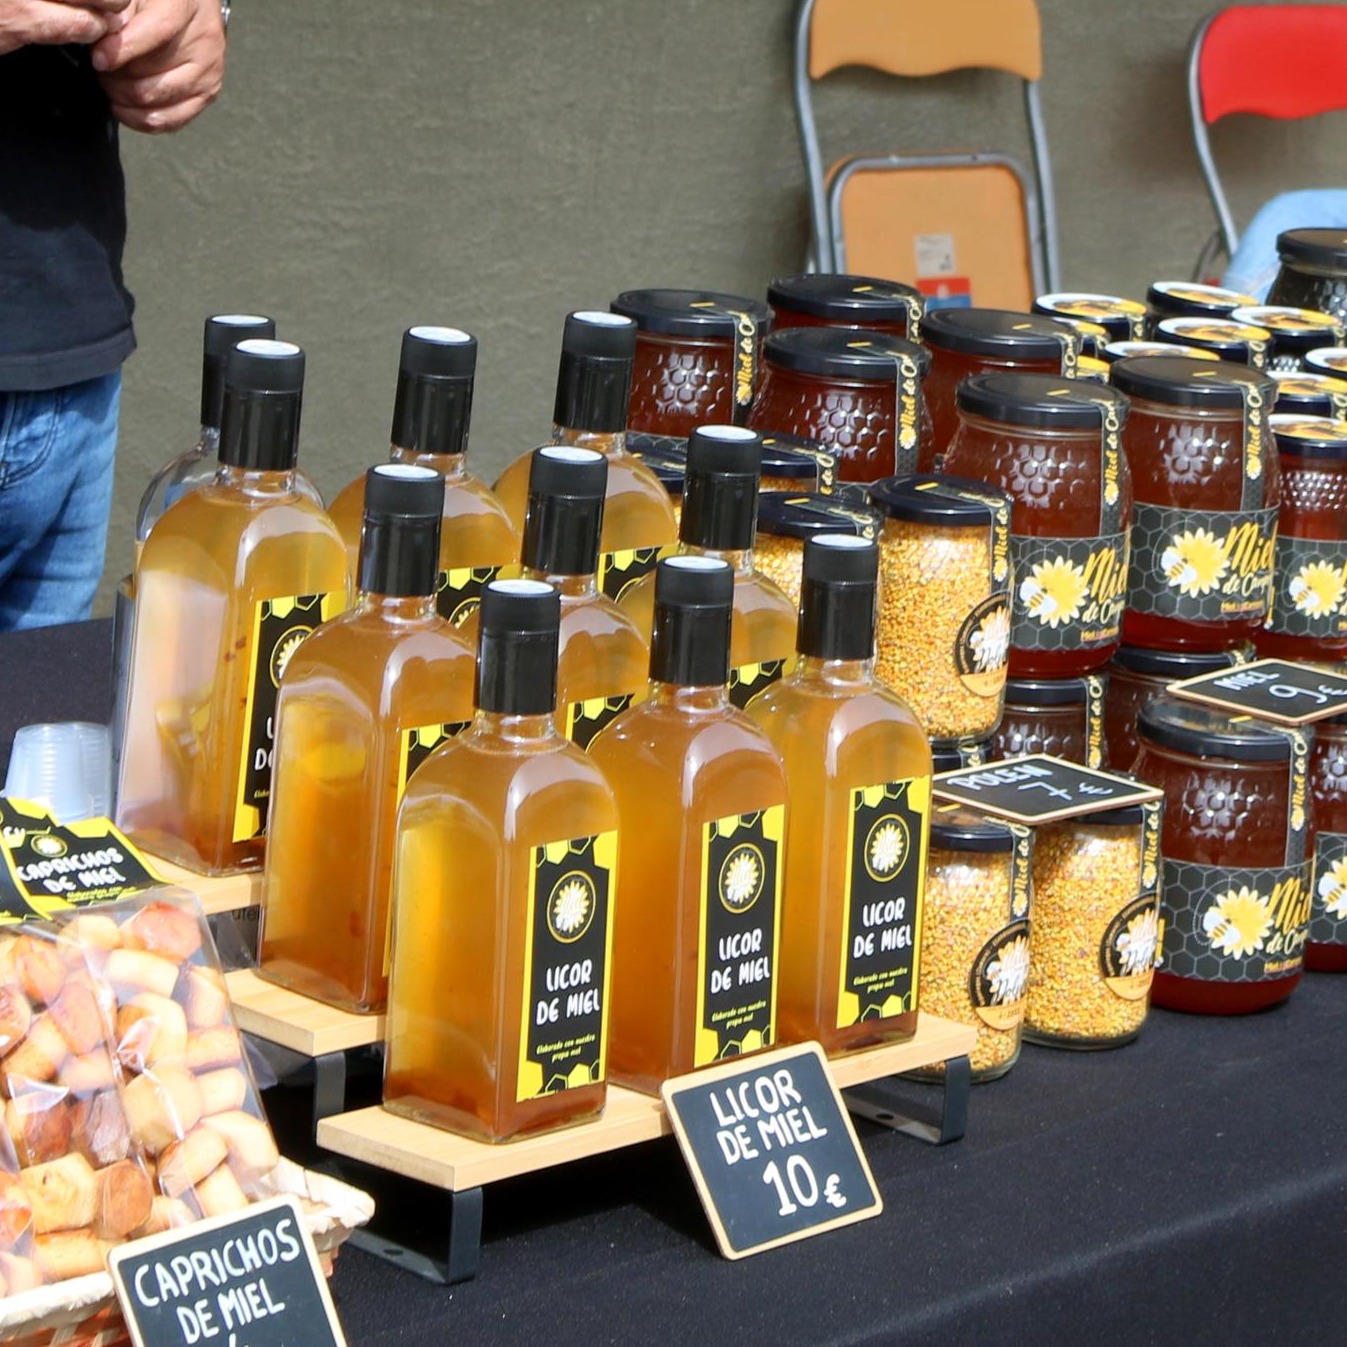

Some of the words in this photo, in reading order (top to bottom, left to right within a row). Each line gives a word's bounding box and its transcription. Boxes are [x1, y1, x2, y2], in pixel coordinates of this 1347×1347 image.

[1213, 670, 1280, 691] MIEL
[947, 764, 1053, 791] POLEN
[16, 847, 124, 881] CAPRICHOS
[43, 876, 77, 893] DE
[77, 866, 126, 888] MIEL
[862, 897, 906, 928] LICOR
[718, 927, 763, 961] LICOR
[853, 933, 875, 959] DE
[881, 925, 913, 952] MIEL
[546, 958, 593, 992] LICOR
[711, 966, 732, 994] DE
[739, 956, 771, 986] MIEL
[536, 997, 560, 1026] DE
[566, 988, 601, 1019] MIEL
[709, 1069, 802, 1127] LICOR
[716, 1124, 760, 1166] DE
[757, 1105, 828, 1152] MIEL
[134, 1218, 300, 1307] CAPRICHOS
[176, 1298, 220, 1345] DE
[217, 1277, 286, 1331] MIEL
